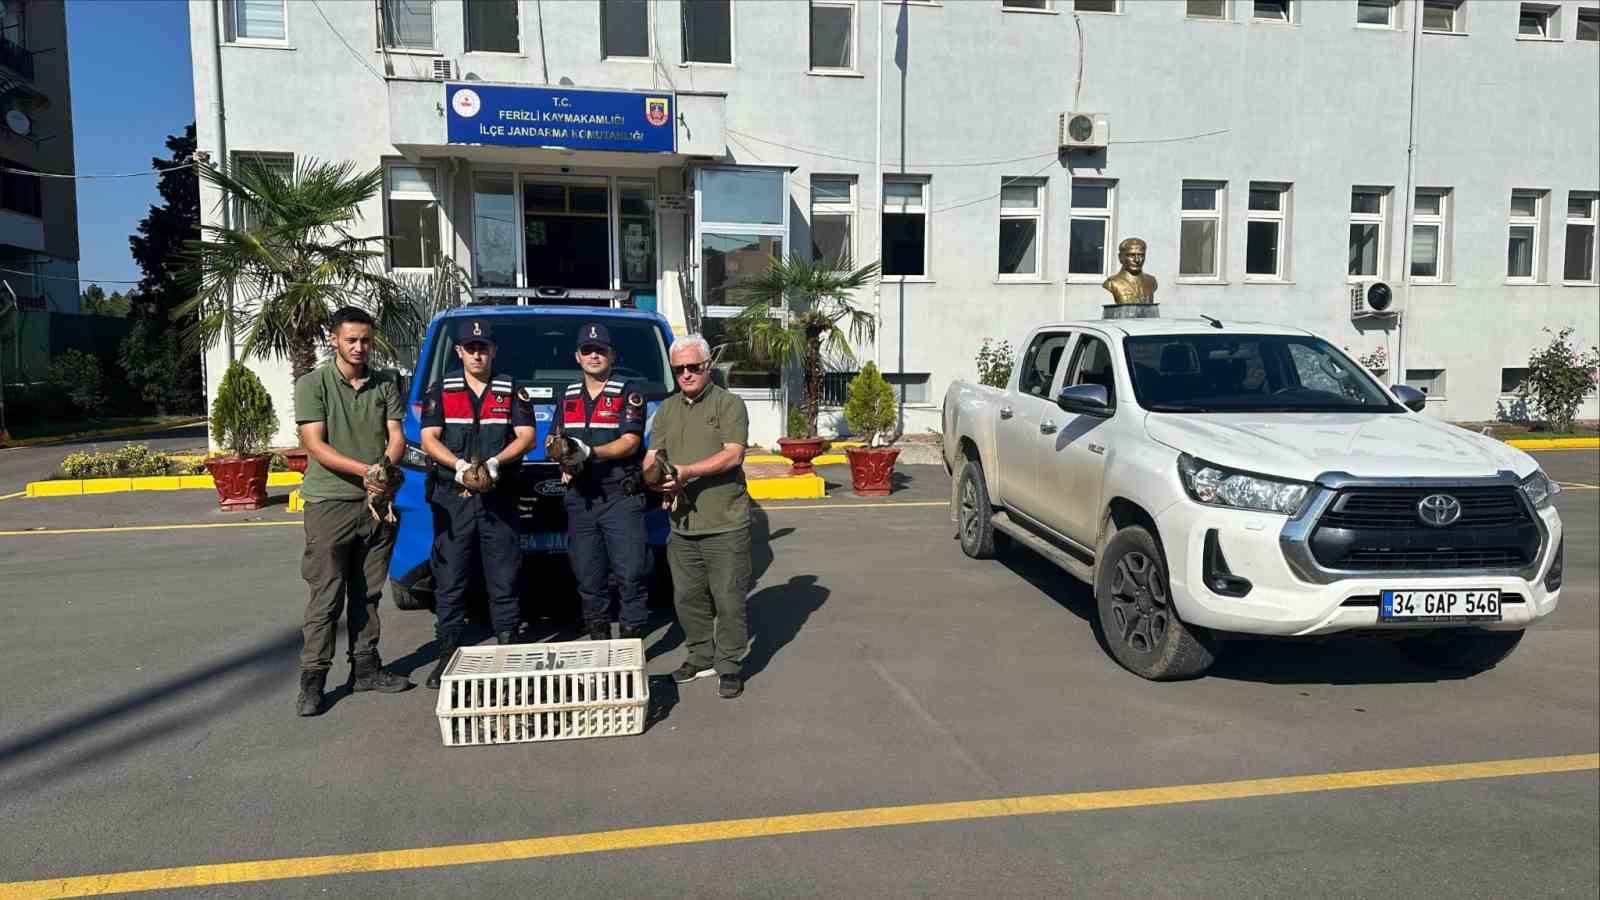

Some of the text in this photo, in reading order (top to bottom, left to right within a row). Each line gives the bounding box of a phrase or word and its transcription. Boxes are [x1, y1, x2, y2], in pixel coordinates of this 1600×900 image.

[552, 97, 572, 108] T.C.
[499, 109, 540, 122] FERİZLİ
[479, 122, 505, 136] İLÇE
[507, 126, 568, 139] JANDARMA
[1394, 593, 1415, 614] 34
[1425, 593, 1457, 614] GAP
[1465, 592, 1497, 614] 546
